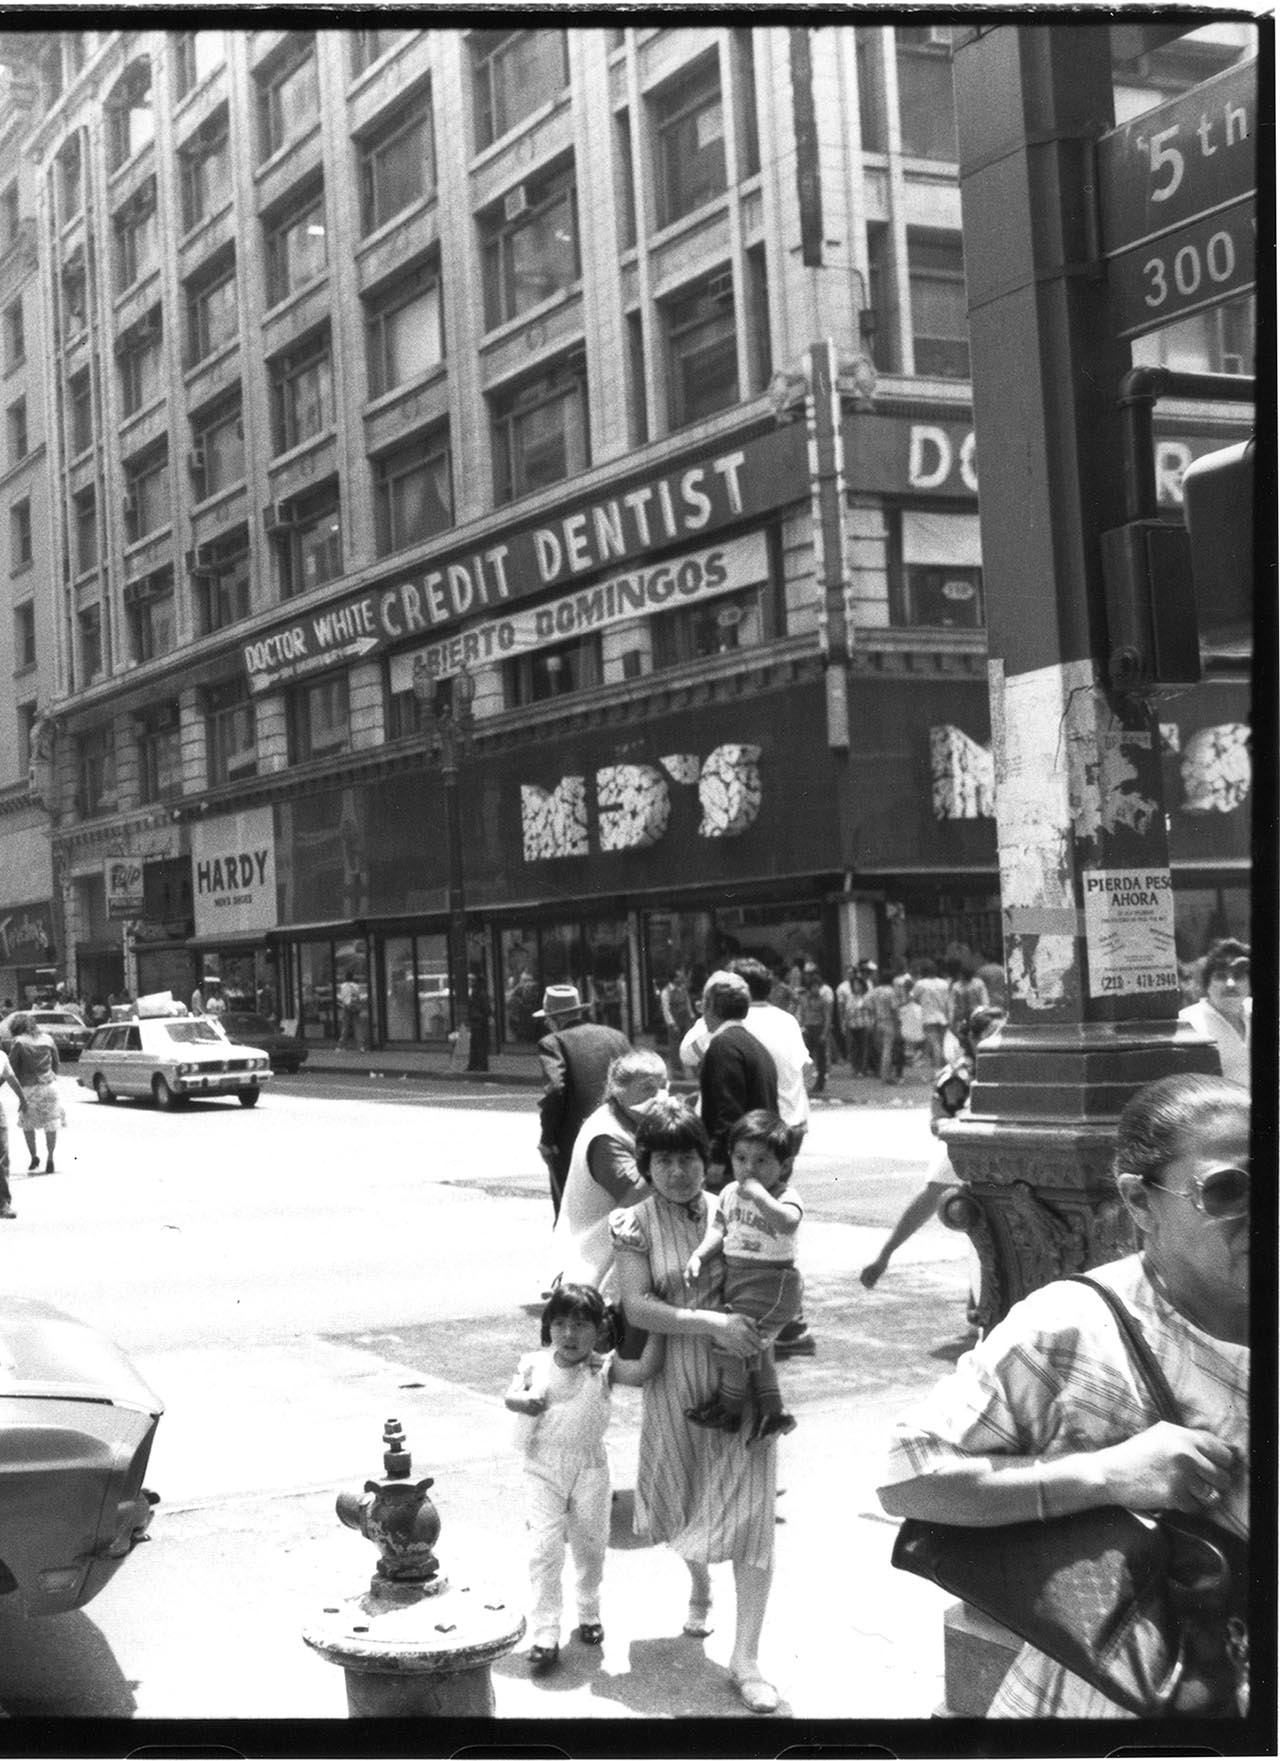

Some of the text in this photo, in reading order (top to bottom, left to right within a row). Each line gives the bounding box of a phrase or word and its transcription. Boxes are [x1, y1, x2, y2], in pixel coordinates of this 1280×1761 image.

[1143, 231, 1236, 307] 300
[380, 451, 745, 637] CREDIT DENTIST
[536, 552, 728, 638] DOMINGOS
[244, 626, 308, 673] DOCTOR
[313, 599, 377, 647] WHITE
[197, 850, 268, 894] HARDY
[1087, 876, 1142, 893] PIERDA
[1111, 892, 1159, 907] AHORA
